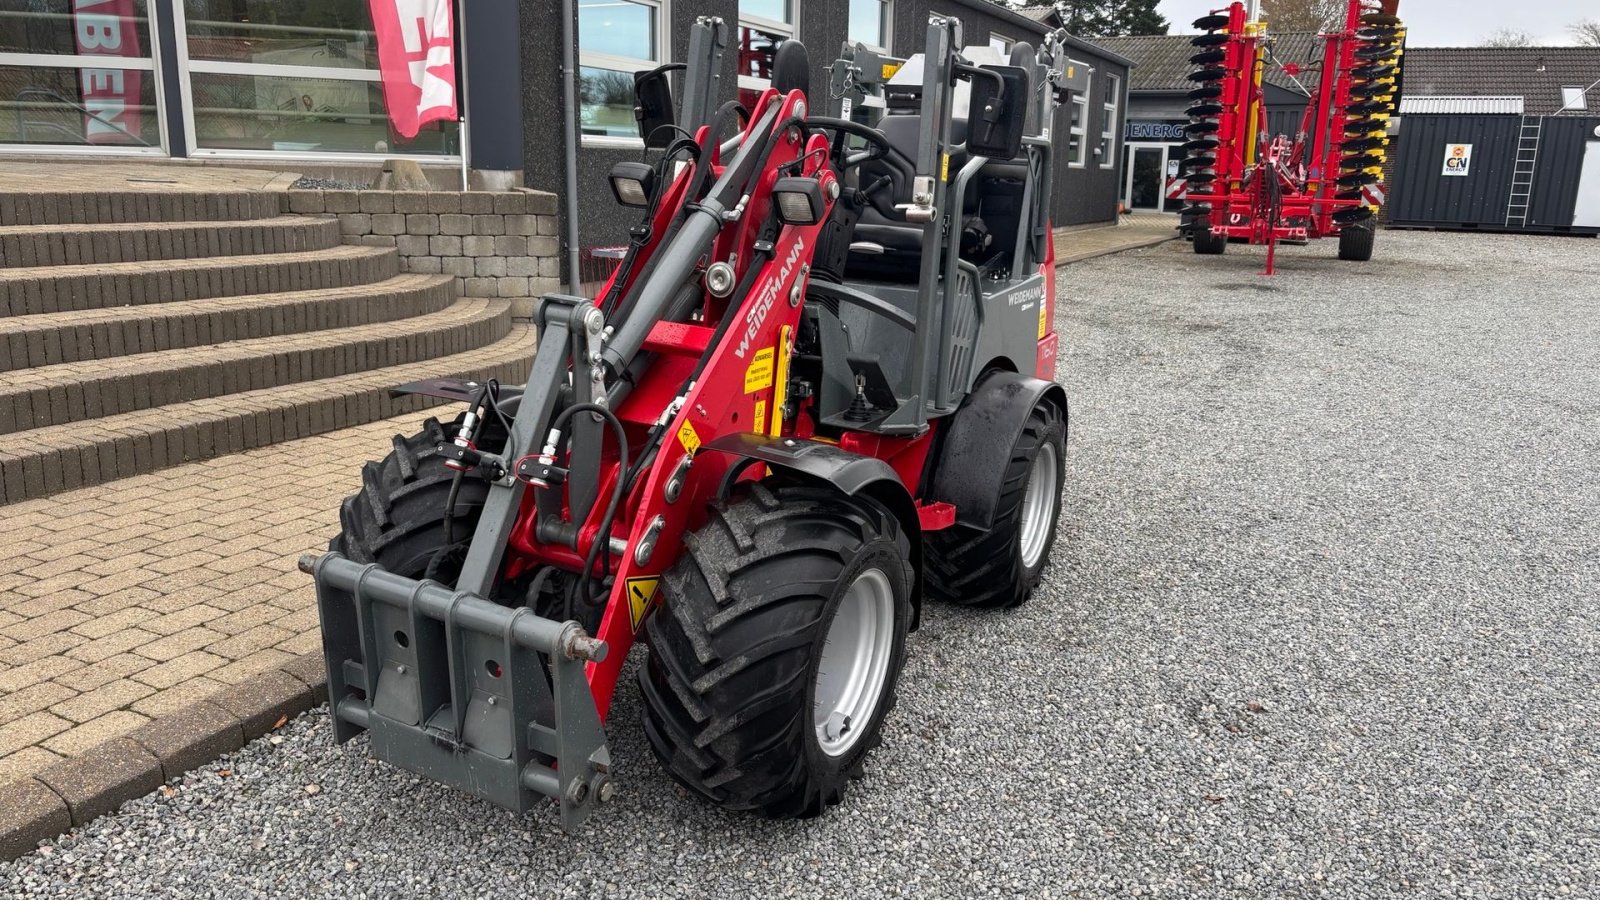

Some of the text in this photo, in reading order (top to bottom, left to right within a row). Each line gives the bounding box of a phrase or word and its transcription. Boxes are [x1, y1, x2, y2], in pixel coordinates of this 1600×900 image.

[75, 0, 128, 134] BEN
[1131, 124, 1189, 138] ENERG
[735, 236, 804, 358] WEIDEMANN
[1008, 287, 1041, 306] WEIDEMANN
